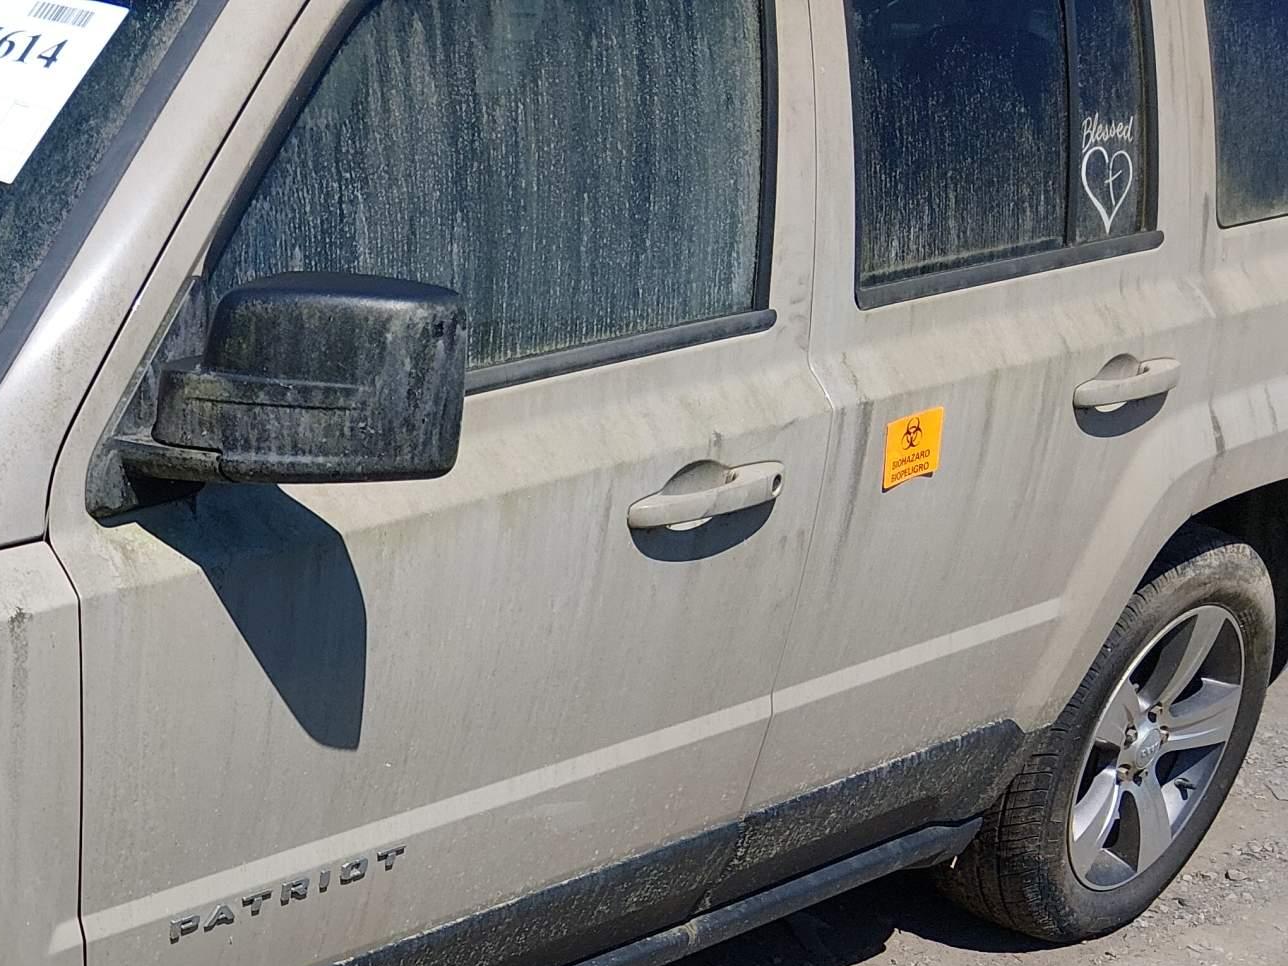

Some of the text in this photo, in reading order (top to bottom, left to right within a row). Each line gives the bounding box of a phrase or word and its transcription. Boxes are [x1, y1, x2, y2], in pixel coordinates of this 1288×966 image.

[1081, 112, 1134, 152] Blessed
[890, 461, 930, 482] BIOPELIGRO
[169, 845, 406, 944] PATRIOT
